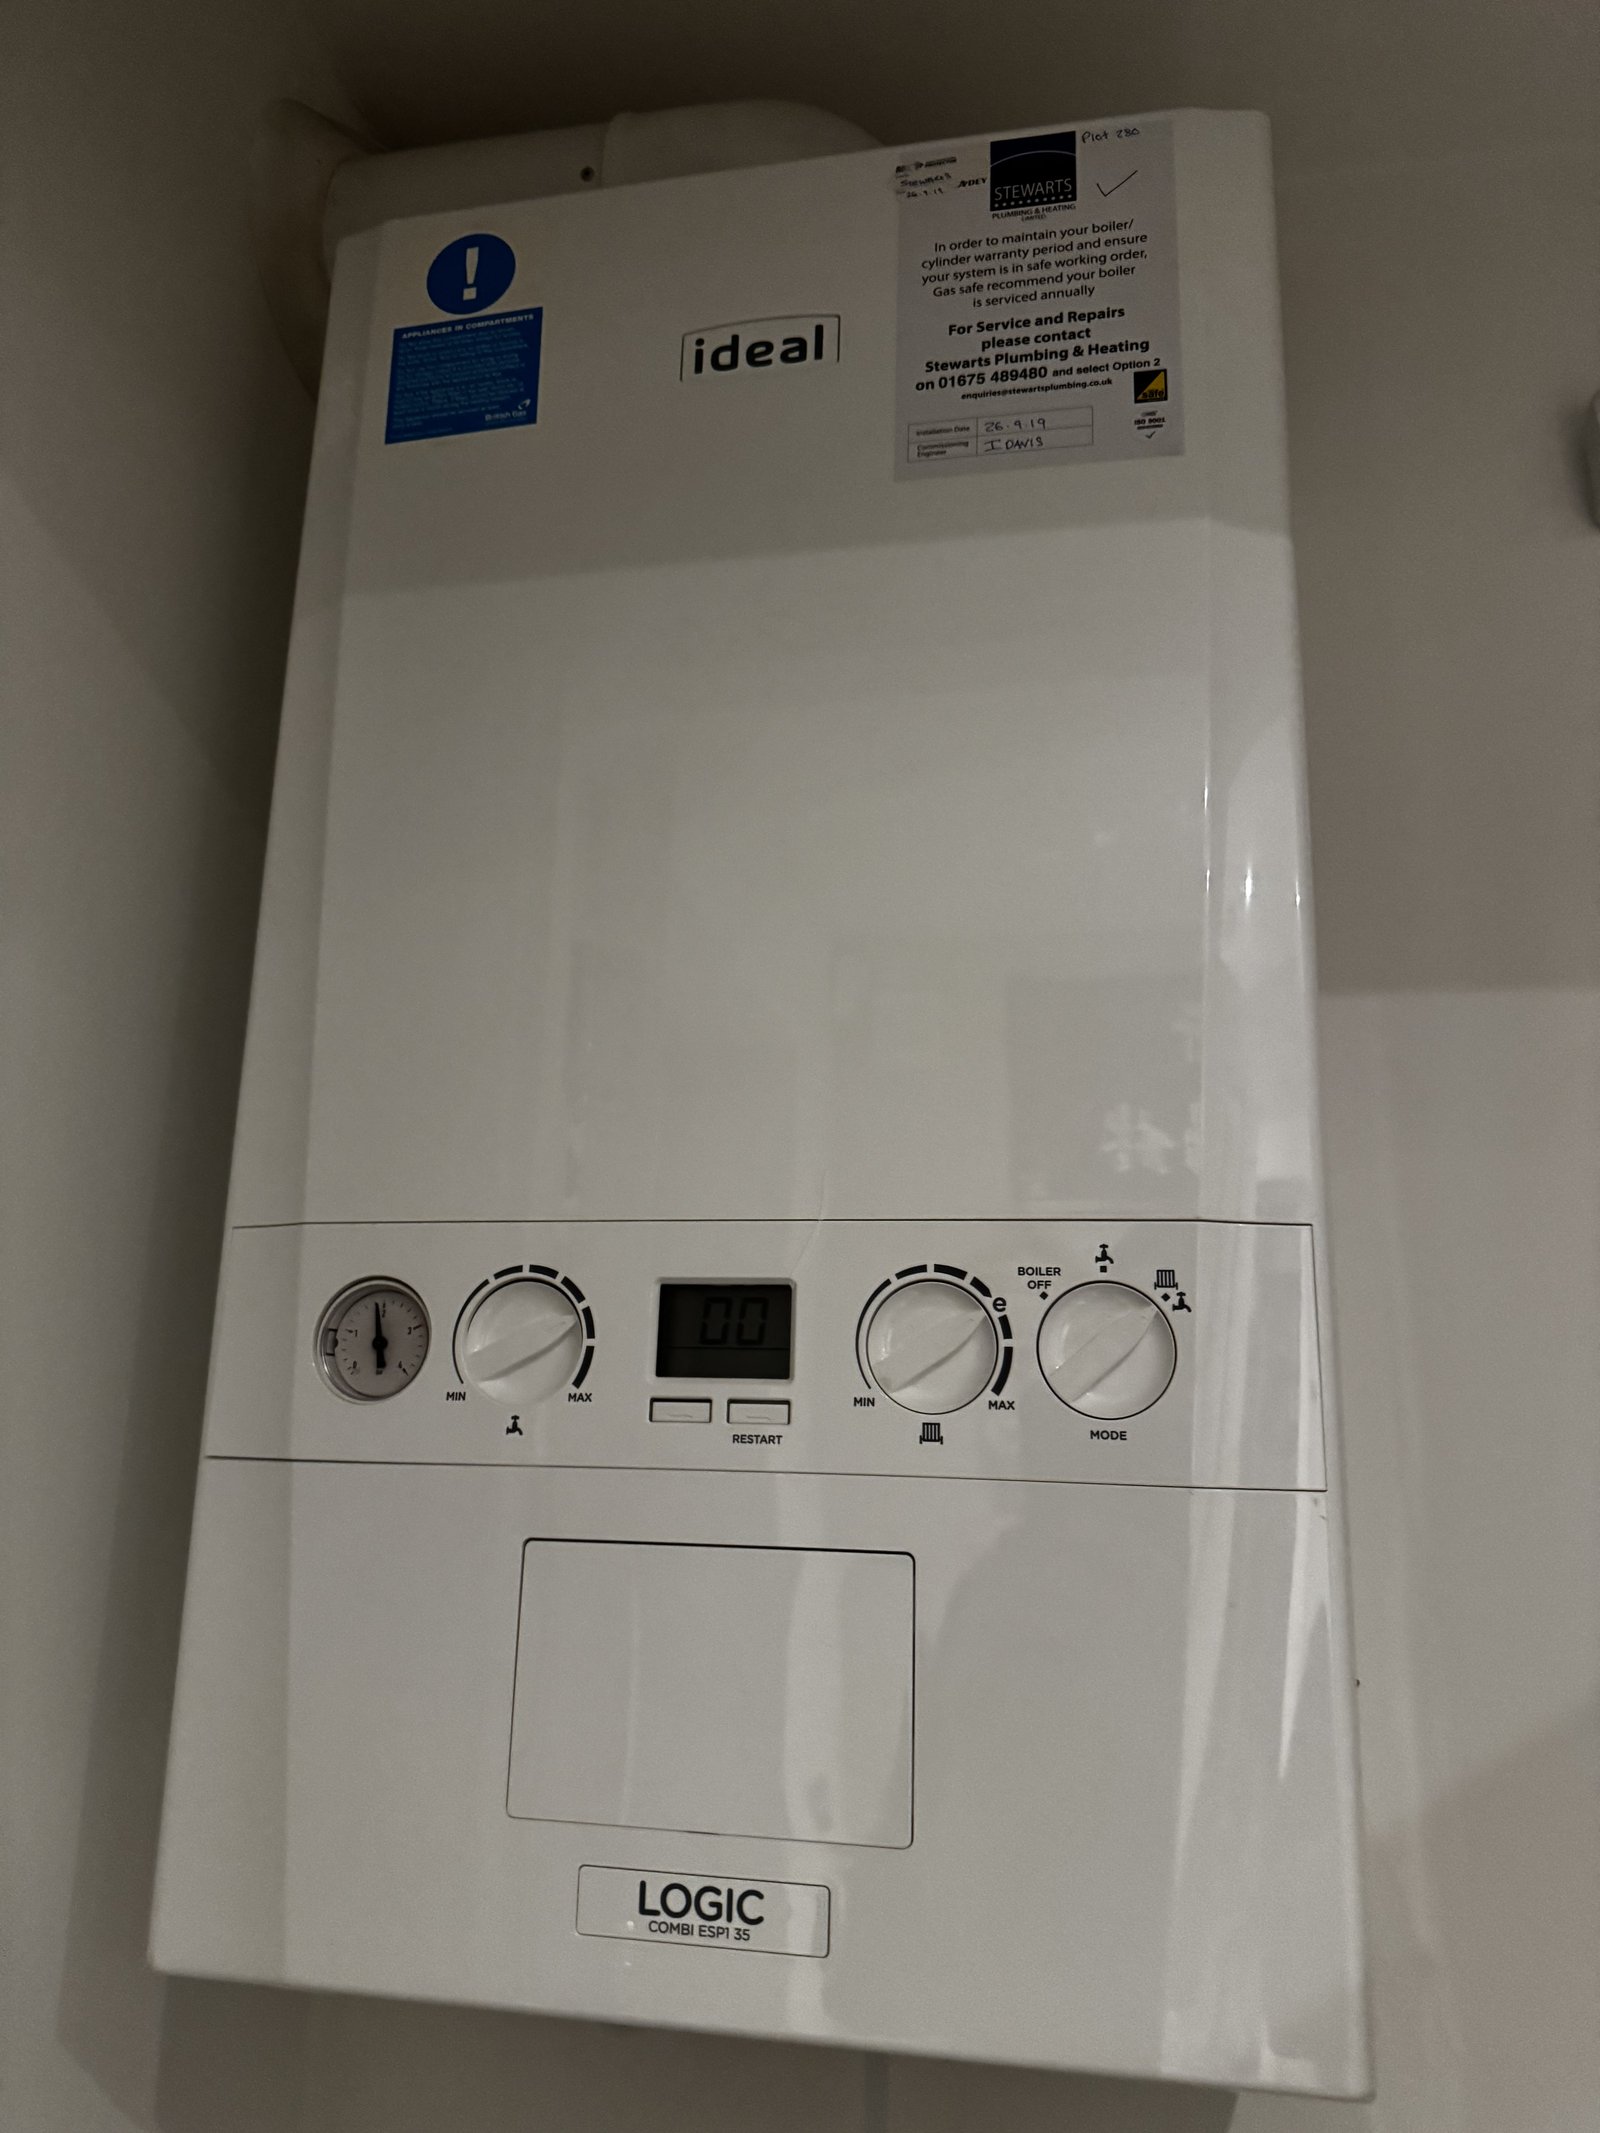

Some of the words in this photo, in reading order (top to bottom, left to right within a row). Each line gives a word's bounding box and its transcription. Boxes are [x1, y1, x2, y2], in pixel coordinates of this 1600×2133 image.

[994, 178, 1072, 200] STEWARTS
[992, 210, 1032, 220] PLUMBING
[1032, 207, 1040, 215] &
[1042, 203, 1076, 213] HEATING
[934, 242, 946, 252] In
[950, 238, 982, 251] order
[986, 235, 998, 246] to
[1002, 228, 1056, 246] maintain
[1060, 224, 1088, 240] your
[1092, 218, 1134, 234] boiler/
[922, 253, 970, 270] cylinder
[974, 248, 1030, 265] warranty
[1032, 242, 1074, 258] period
[1077, 238, 1100, 250] and
[1104, 234, 1148, 248] ensure
[922, 271, 949, 286] your
[953, 266, 996, 282] system
[1000, 264, 1008, 275] is
[1012, 262, 1024, 274] in
[1027, 259, 1051, 272] safe
[1055, 253, 1106, 272] working
[1110, 248, 1148, 262] order,
[933, 286, 956, 298] Gas
[959, 281, 984, 294] safe
[987, 272, 1064, 291] recommend
[1066, 270, 1096, 286] your
[1098, 264, 1135, 278] boiler
[974, 298, 982, 308] is
[985, 290, 1037, 306] serviced
[1040, 284, 1095, 302] annually
[402, 326, 452, 339] APPLIANCES
[466, 314, 534, 330] COMPARTMENTS
[948, 323, 973, 336] For
[976, 317, 1031, 333] Service
[1034, 312, 1064, 326] and
[1068, 306, 1124, 326] Repairs
[694, 324, 824, 375] ideal
[981, 335, 1030, 352] please
[1034, 328, 1091, 344] contact
[925, 356, 990, 373] Stewarts
[994, 346, 1068, 366] Plumbing
[1072, 344, 1084, 357] &
[1088, 338, 1149, 356] Heating
[916, 380, 934, 391] on
[938, 372, 985, 389] 01675
[990, 366, 1048, 384] 489480
[1052, 368, 1073, 378] and
[1076, 363, 1108, 374] select
[1112, 358, 1150, 374] Option
[1154, 358, 1160, 367] 2
[962, 378, 1112, 400] enquiries@stewartsplumbing.co.uk
[954, 424, 970, 433] Date
[1134, 418, 1146, 426] ISO
[1006, 436, 1044, 450] DAVIS
[1017, 1266, 1062, 1277] BOILER
[1026, 1280, 1052, 1290] OFF
[446, 1391, 467, 1402] MIN
[567, 1392, 593, 1403] MAX
[853, 1396, 876, 1408] MIN
[988, 1400, 1015, 1411] MAX
[732, 1433, 783, 1446] RESTART
[1089, 1430, 1128, 1441] MODE
[638, 1879, 765, 1926] LOGIC
[648, 1920, 695, 1936] COMBI
[698, 1925, 730, 1939] ESP1
[733, 1928, 751, 1942] 35
